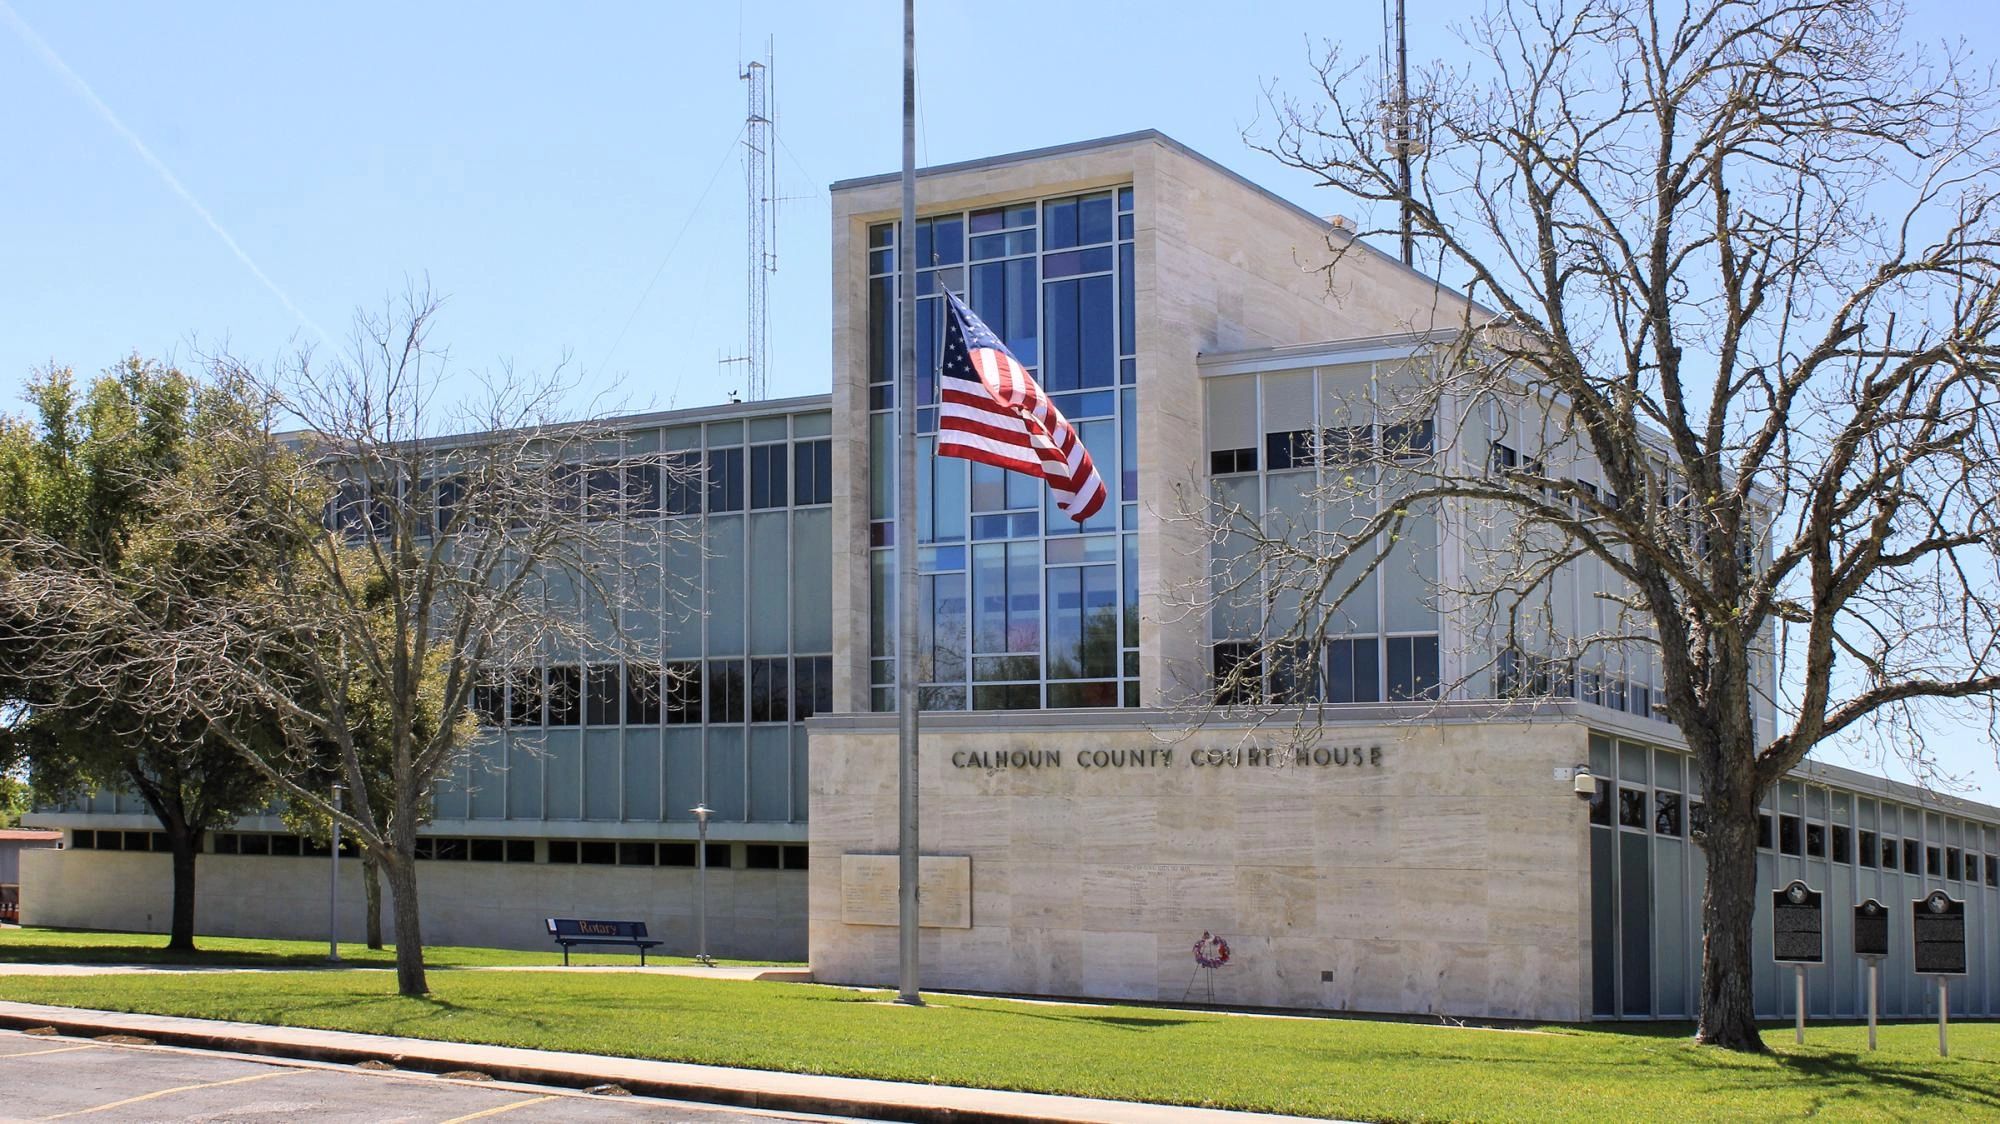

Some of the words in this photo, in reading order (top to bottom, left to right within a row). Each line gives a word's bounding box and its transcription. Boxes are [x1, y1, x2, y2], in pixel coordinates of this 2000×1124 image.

[952, 749, 1060, 768] CALHOUN
[1077, 749, 1173, 768] COUNTY
[1191, 747, 1274, 768] COURT
[1296, 747, 1382, 767] HOUSE
[579, 920, 616, 935] Rotary
